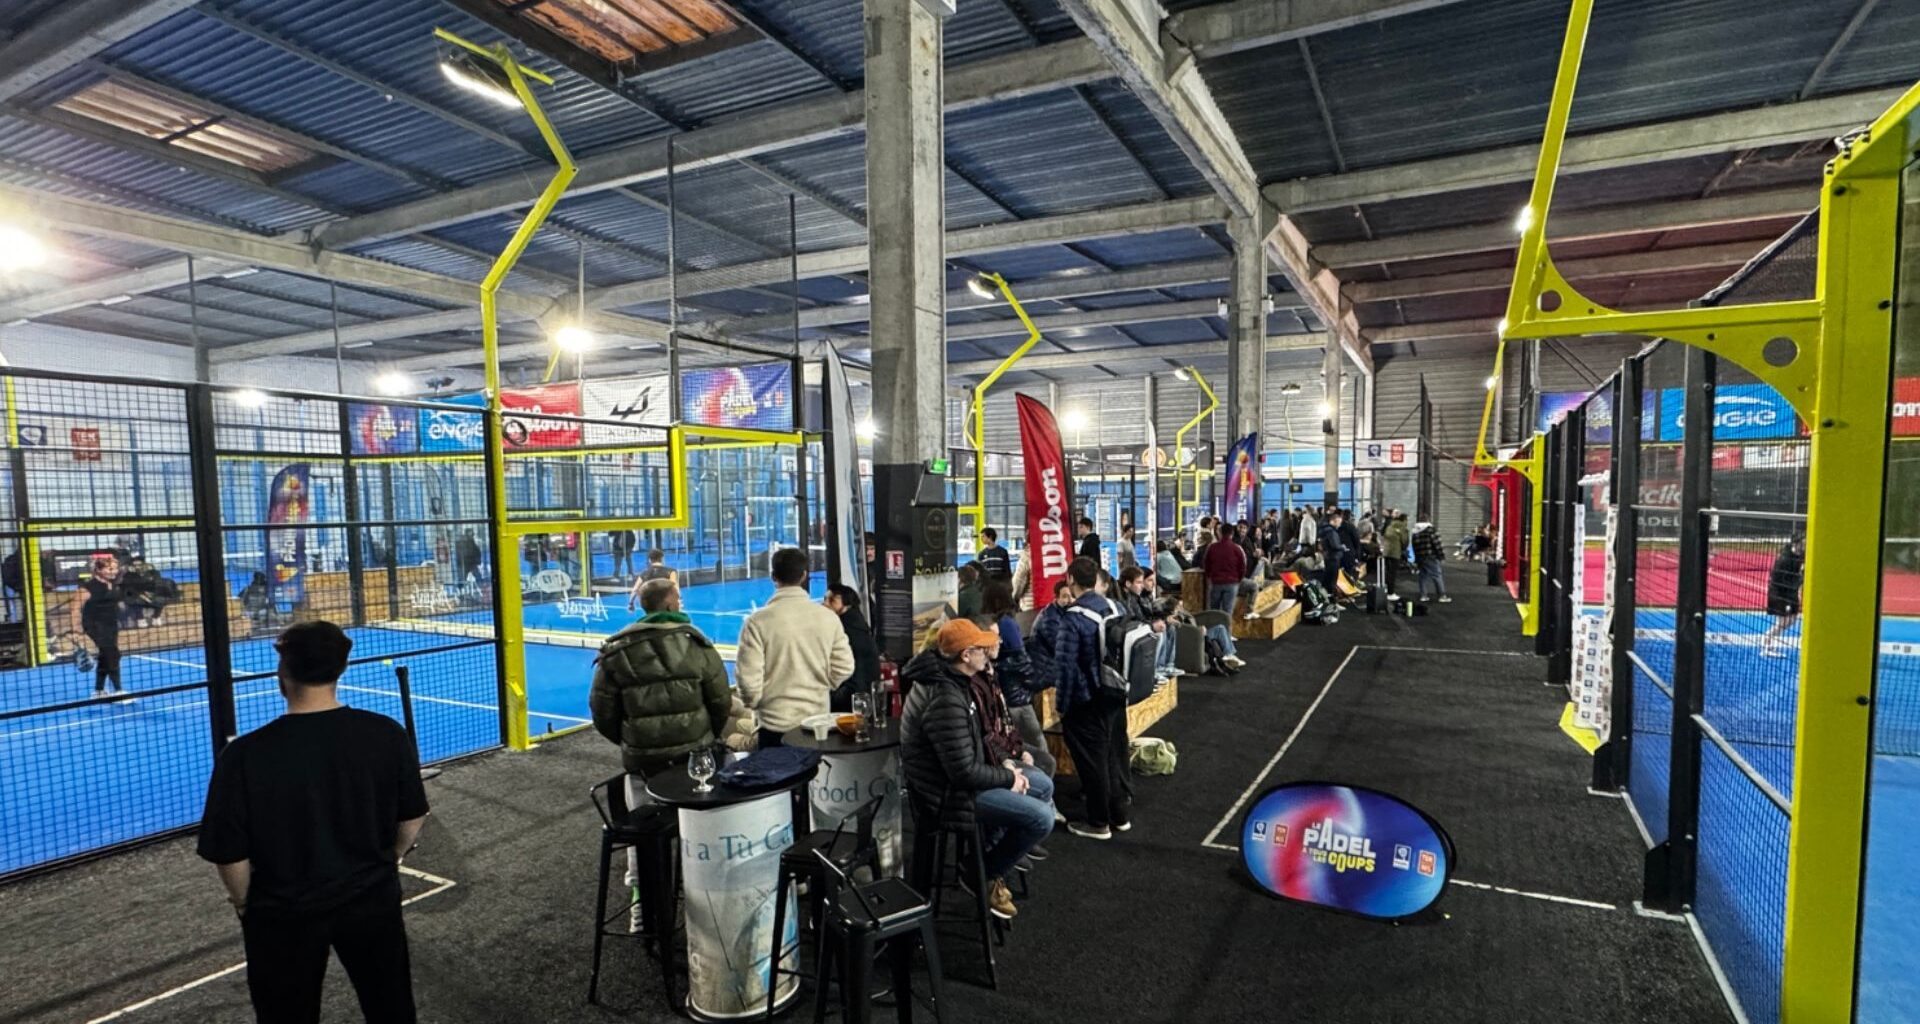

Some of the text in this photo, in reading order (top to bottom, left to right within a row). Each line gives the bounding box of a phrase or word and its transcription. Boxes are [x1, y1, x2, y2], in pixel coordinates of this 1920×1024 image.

[1038, 464, 1069, 578] Wilson
[718, 833, 754, 860] Tù
[1302, 817, 1377, 859] PADEL
[1328, 851, 1376, 873] COUPS
